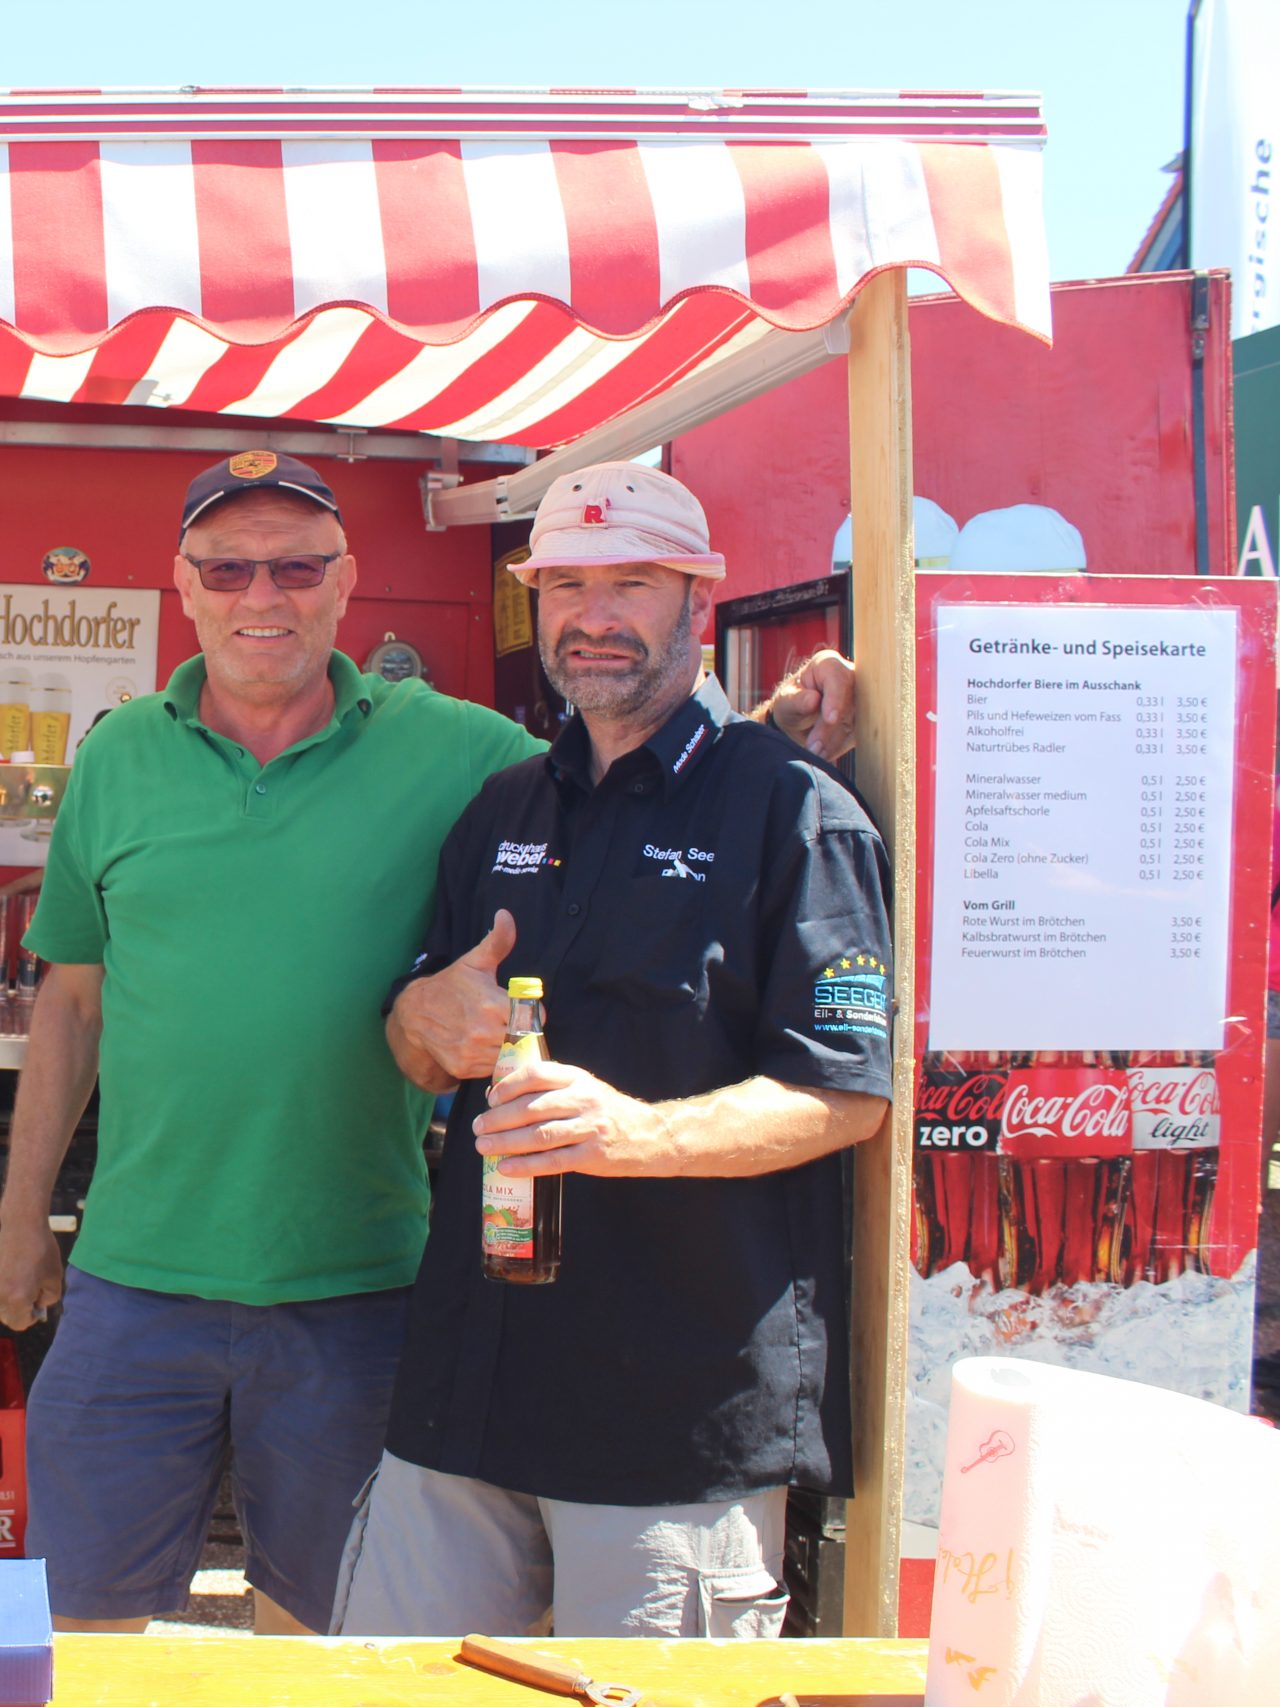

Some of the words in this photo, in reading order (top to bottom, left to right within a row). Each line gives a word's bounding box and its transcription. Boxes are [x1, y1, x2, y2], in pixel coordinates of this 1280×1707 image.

[584, 504, 604, 524] R
[969, 639, 1058, 654] Getränke-
[1064, 640, 1096, 655] und
[1102, 641, 1205, 659] Speisekarte
[33, 654, 72, 663] unserem
[73, 655, 136, 666] Hopfengarten
[968, 679, 1031, 688] Hochdorfer
[1035, 679, 1063, 689] Biere
[1066, 680, 1079, 689] im
[1083, 680, 1141, 690] Ausschank
[967, 694, 987, 704] Bier
[1136, 697, 1158, 707] 0,33
[1177, 697, 1198, 708] 3,50
[967, 710, 984, 720] Pils
[987, 711, 1008, 720] und
[1011, 710, 1071, 721] Hefeweizen
[1100, 712, 1121, 722] Fass
[1136, 712, 1158, 723] 0,33
[1177, 713, 1198, 723] 3,50
[967, 726, 1023, 736] Alkoholfrei
[1136, 728, 1157, 739] 0,33
[1177, 729, 1198, 739] 3,50
[967, 742, 1030, 752] Naturtrübes
[1033, 743, 1066, 753] Radler
[1136, 744, 1157, 754] 0,33
[1176, 744, 1198, 755] 3,50
[966, 774, 1040, 784] Mineralwasser
[1141, 776, 1157, 786] 0,5
[1176, 776, 1197, 786] 2,50
[966, 790, 1040, 800] Mineralwasser
[1044, 790, 1087, 800] medium
[1141, 791, 1156, 801] 0,5
[1175, 792, 1196, 802] 2,50
[965, 805, 1049, 817] Apfelsaftschorle
[1141, 807, 1156, 817] 0,5
[1175, 807, 1196, 817] 2,50
[965, 821, 988, 831] Cola
[1140, 823, 1156, 833] 0,5
[1174, 823, 1195, 833] 2,50
[965, 837, 988, 847] Cola
[991, 838, 1009, 846] Mix
[1140, 838, 1155, 849] 0,5
[1174, 839, 1195, 849] 2,50
[643, 844, 682, 860] Stefan
[964, 853, 988, 863] Cola
[990, 853, 1014, 863] Zero
[1017, 853, 1047, 864] (ohne
[1051, 853, 1088, 864] Zucker)
[1140, 854, 1155, 864] 0,5
[1174, 854, 1195, 864] 2,50
[964, 869, 998, 879] Libella
[1139, 870, 1154, 880] 0,5
[1173, 870, 1194, 880] 2,50
[964, 901, 988, 910] Vom
[992, 900, 1015, 910] Grill
[963, 916, 987, 926] Rote
[989, 917, 1019, 926] Wurst
[1022, 917, 1035, 926] im
[1038, 916, 1085, 926] Brötchen
[1172, 917, 1193, 927] 3,50
[963, 932, 1040, 942] Kalbsbratwurst
[1044, 933, 1057, 941] im
[1060, 932, 1106, 942] Brötchen
[1171, 932, 1192, 943] 3,50
[962, 947, 1020, 957] Feuerwurst
[1024, 948, 1036, 957] im
[1040, 948, 1086, 958] Brötchen
[1170, 948, 1192, 958] 3,50
[835, 1010, 844, 1019] &
[1002, 1084, 1129, 1138] Coca-Cola
[920, 1124, 988, 1147] zero
[1150, 1116, 1209, 1145] light
[496, 1186, 513, 1196] MIX
